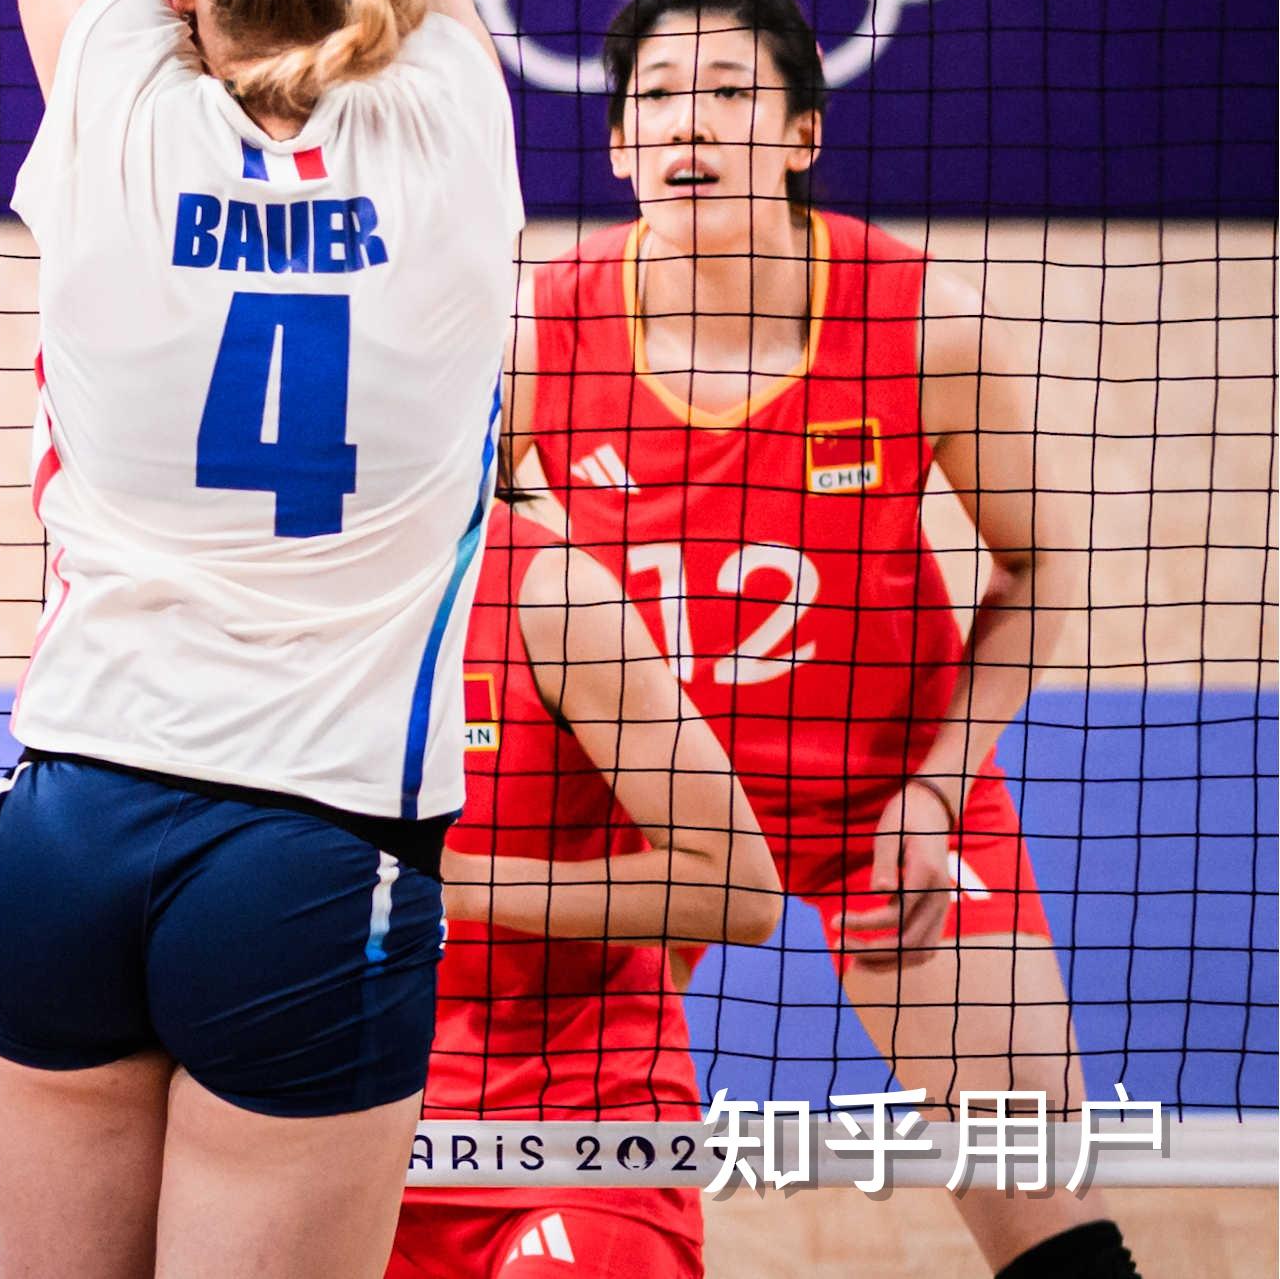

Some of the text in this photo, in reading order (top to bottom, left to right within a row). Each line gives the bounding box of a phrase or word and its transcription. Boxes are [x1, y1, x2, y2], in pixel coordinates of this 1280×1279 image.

[172, 192, 388, 274] BAUER
[196, 291, 357, 538] 4
[819, 469, 871, 489] CHN
[627, 541, 821, 685] 12
[465, 728, 491, 745] HN
